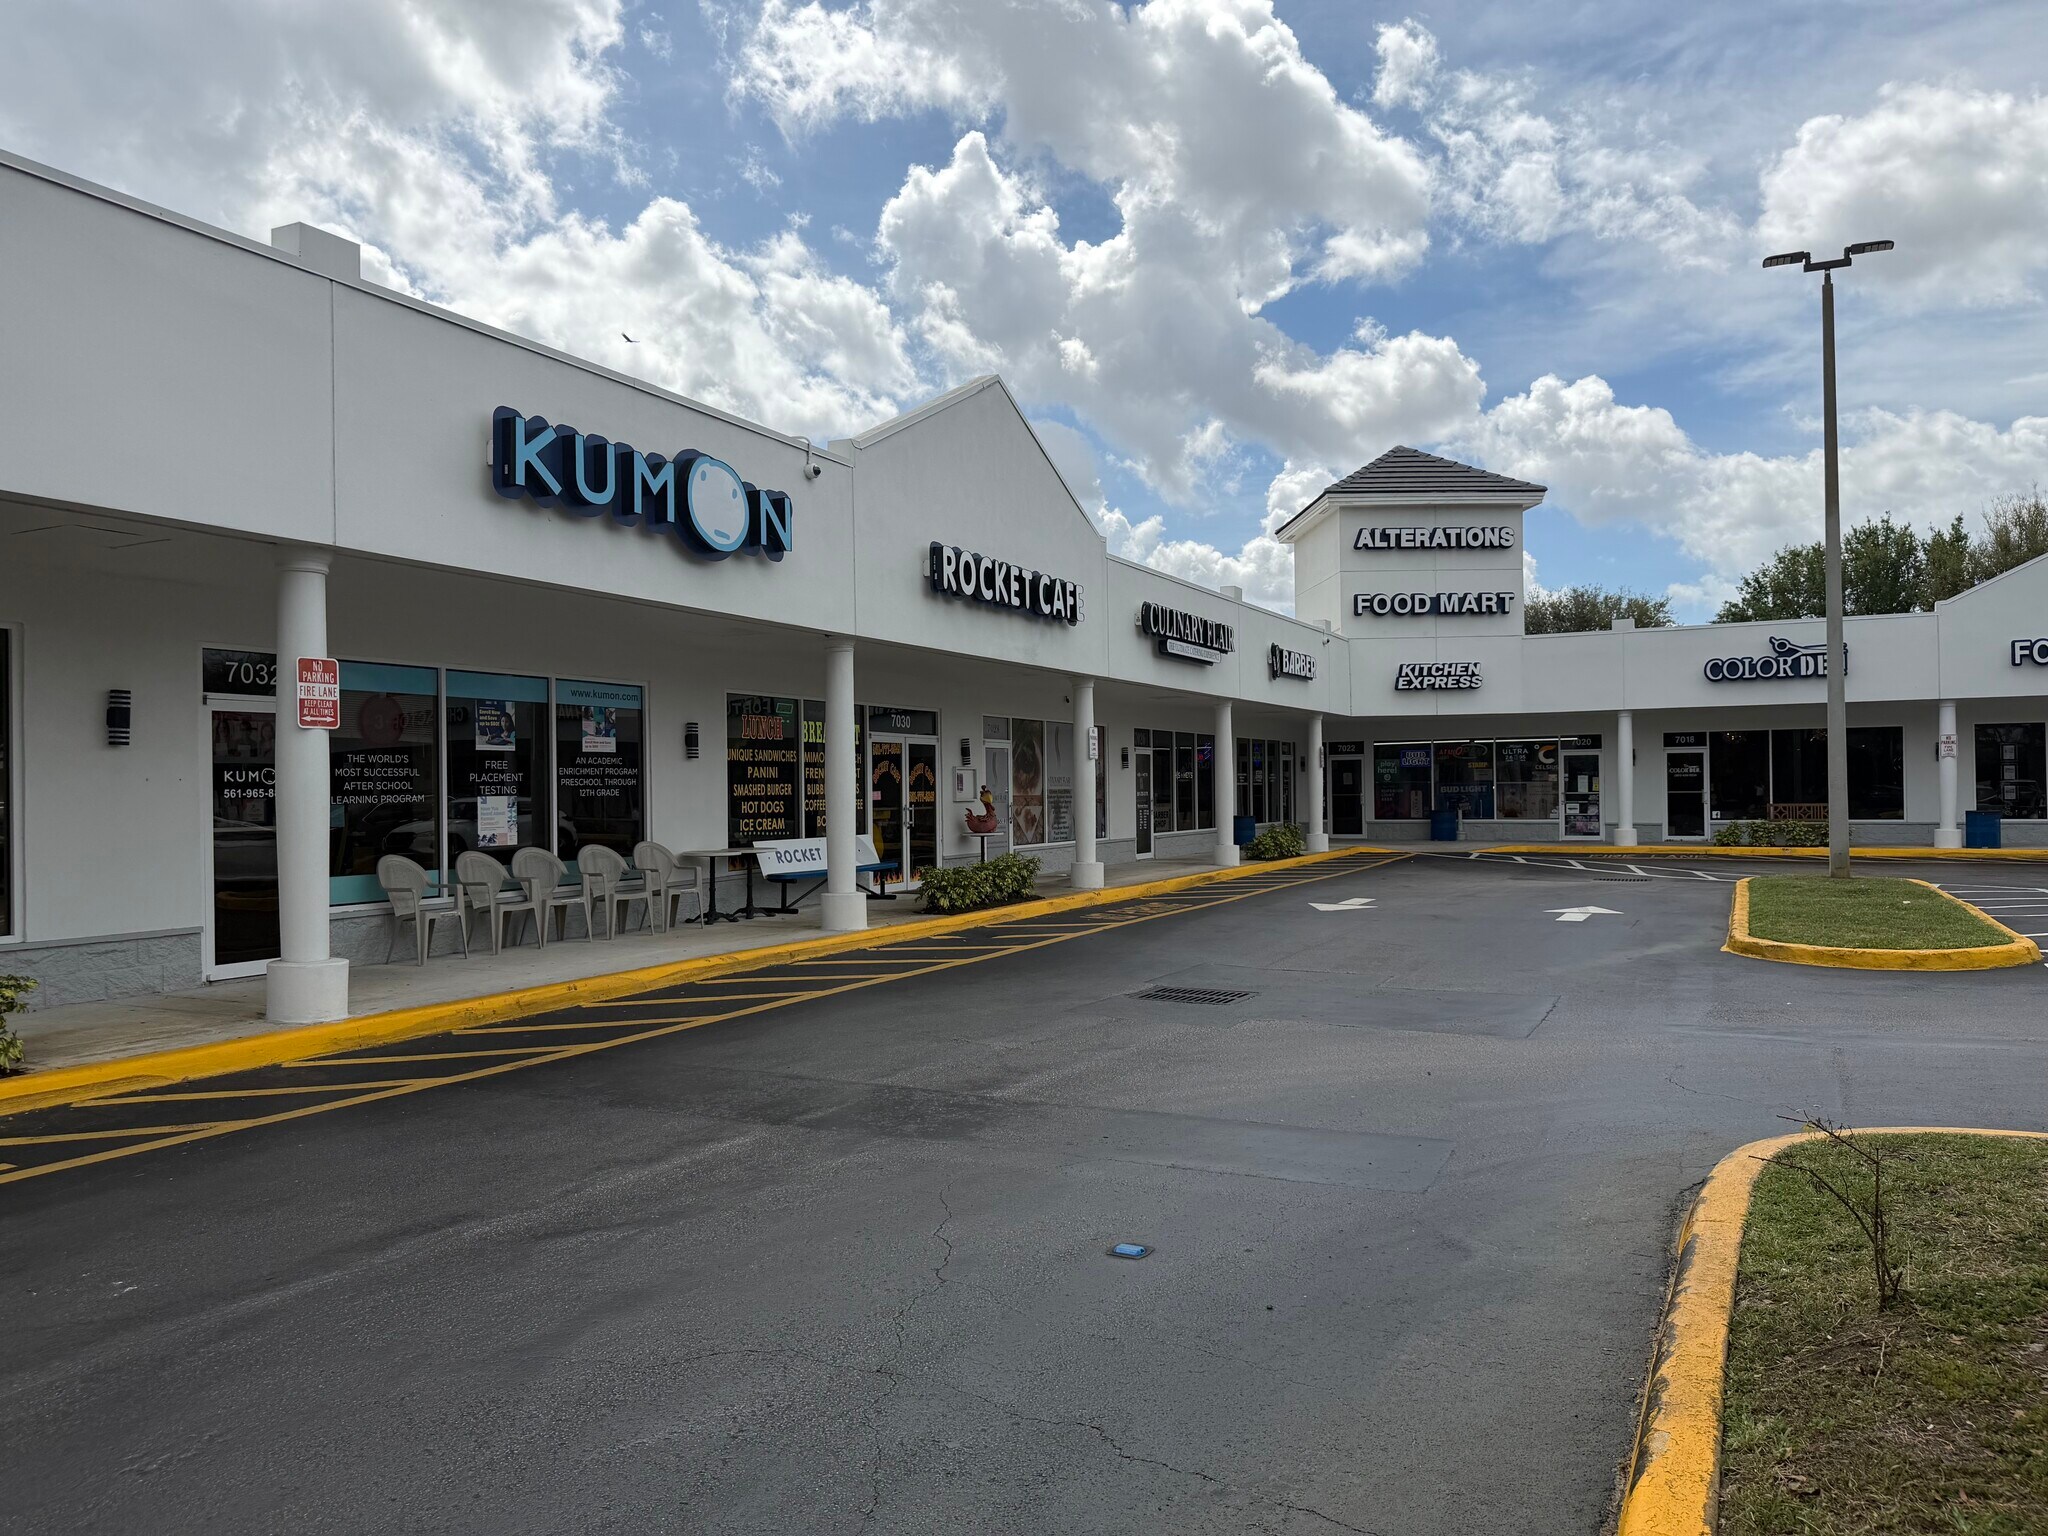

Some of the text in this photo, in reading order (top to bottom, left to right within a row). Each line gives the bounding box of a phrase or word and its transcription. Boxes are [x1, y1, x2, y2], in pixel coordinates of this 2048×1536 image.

[510, 414, 793, 552] KUMON
[1356, 527, 1515, 548] ALTERATIONS
[940, 545, 1086, 622] ROCKET CAFE
[1356, 592, 1515, 614] FOOD MART
[1150, 604, 1235, 652] CULINARY FLAIR
[312, 661, 323, 672] NO
[1283, 649, 1317, 678] BARBER
[1400, 662, 1481, 676] KITCHEN
[1705, 655, 1846, 680] COLOR DE
[302, 671, 335, 684] PARKING
[1397, 675, 1483, 689] EXPRESS
[300, 686, 337, 698] FIRE LANE
[570, 688, 639, 702] www.kumon.com
[317, 700, 333, 708] CLEAR
[320, 708, 334, 716] TIMES
[742, 714, 783, 740] LUNCH
[891, 714, 911, 728] 7030
[1675, 736, 1695, 744] 7018
[1338, 744, 1356, 752] 7022
[347, 754, 409, 763] THE WORLD'S
[575, 757, 623, 765] AN ACADEMIC
[727, 748, 797, 762] UNIQUE SANDWICHES
[485, 761, 508, 770] FREE
[1377, 765, 1398, 773] here!
[1380, 760, 1396, 768] play
[223, 768, 277, 785] KUMO
[335, 768, 420, 777] MOST SUCCESSFUL
[469, 773, 523, 782] PLACEMENT
[559, 768, 638, 776] ENRICHMENT PROGRAM
[747, 766, 779, 779] PANINI
[343, 781, 413, 790] AFTER SCHOOL
[560, 778, 637, 786] PRESCHOOL THROUGH
[223, 789, 276, 798] 561-965-8
[479, 785, 517, 794] TESTING
[579, 789, 620, 797] 12TH GRADE
[733, 784, 793, 796] SMASHED BURGER
[331, 794, 425, 805] LEARNING PROGRAM
[741, 801, 785, 813] HOT DOGS
[740, 818, 785, 831] ICE CREAM
[775, 847, 823, 864] ROCKET
